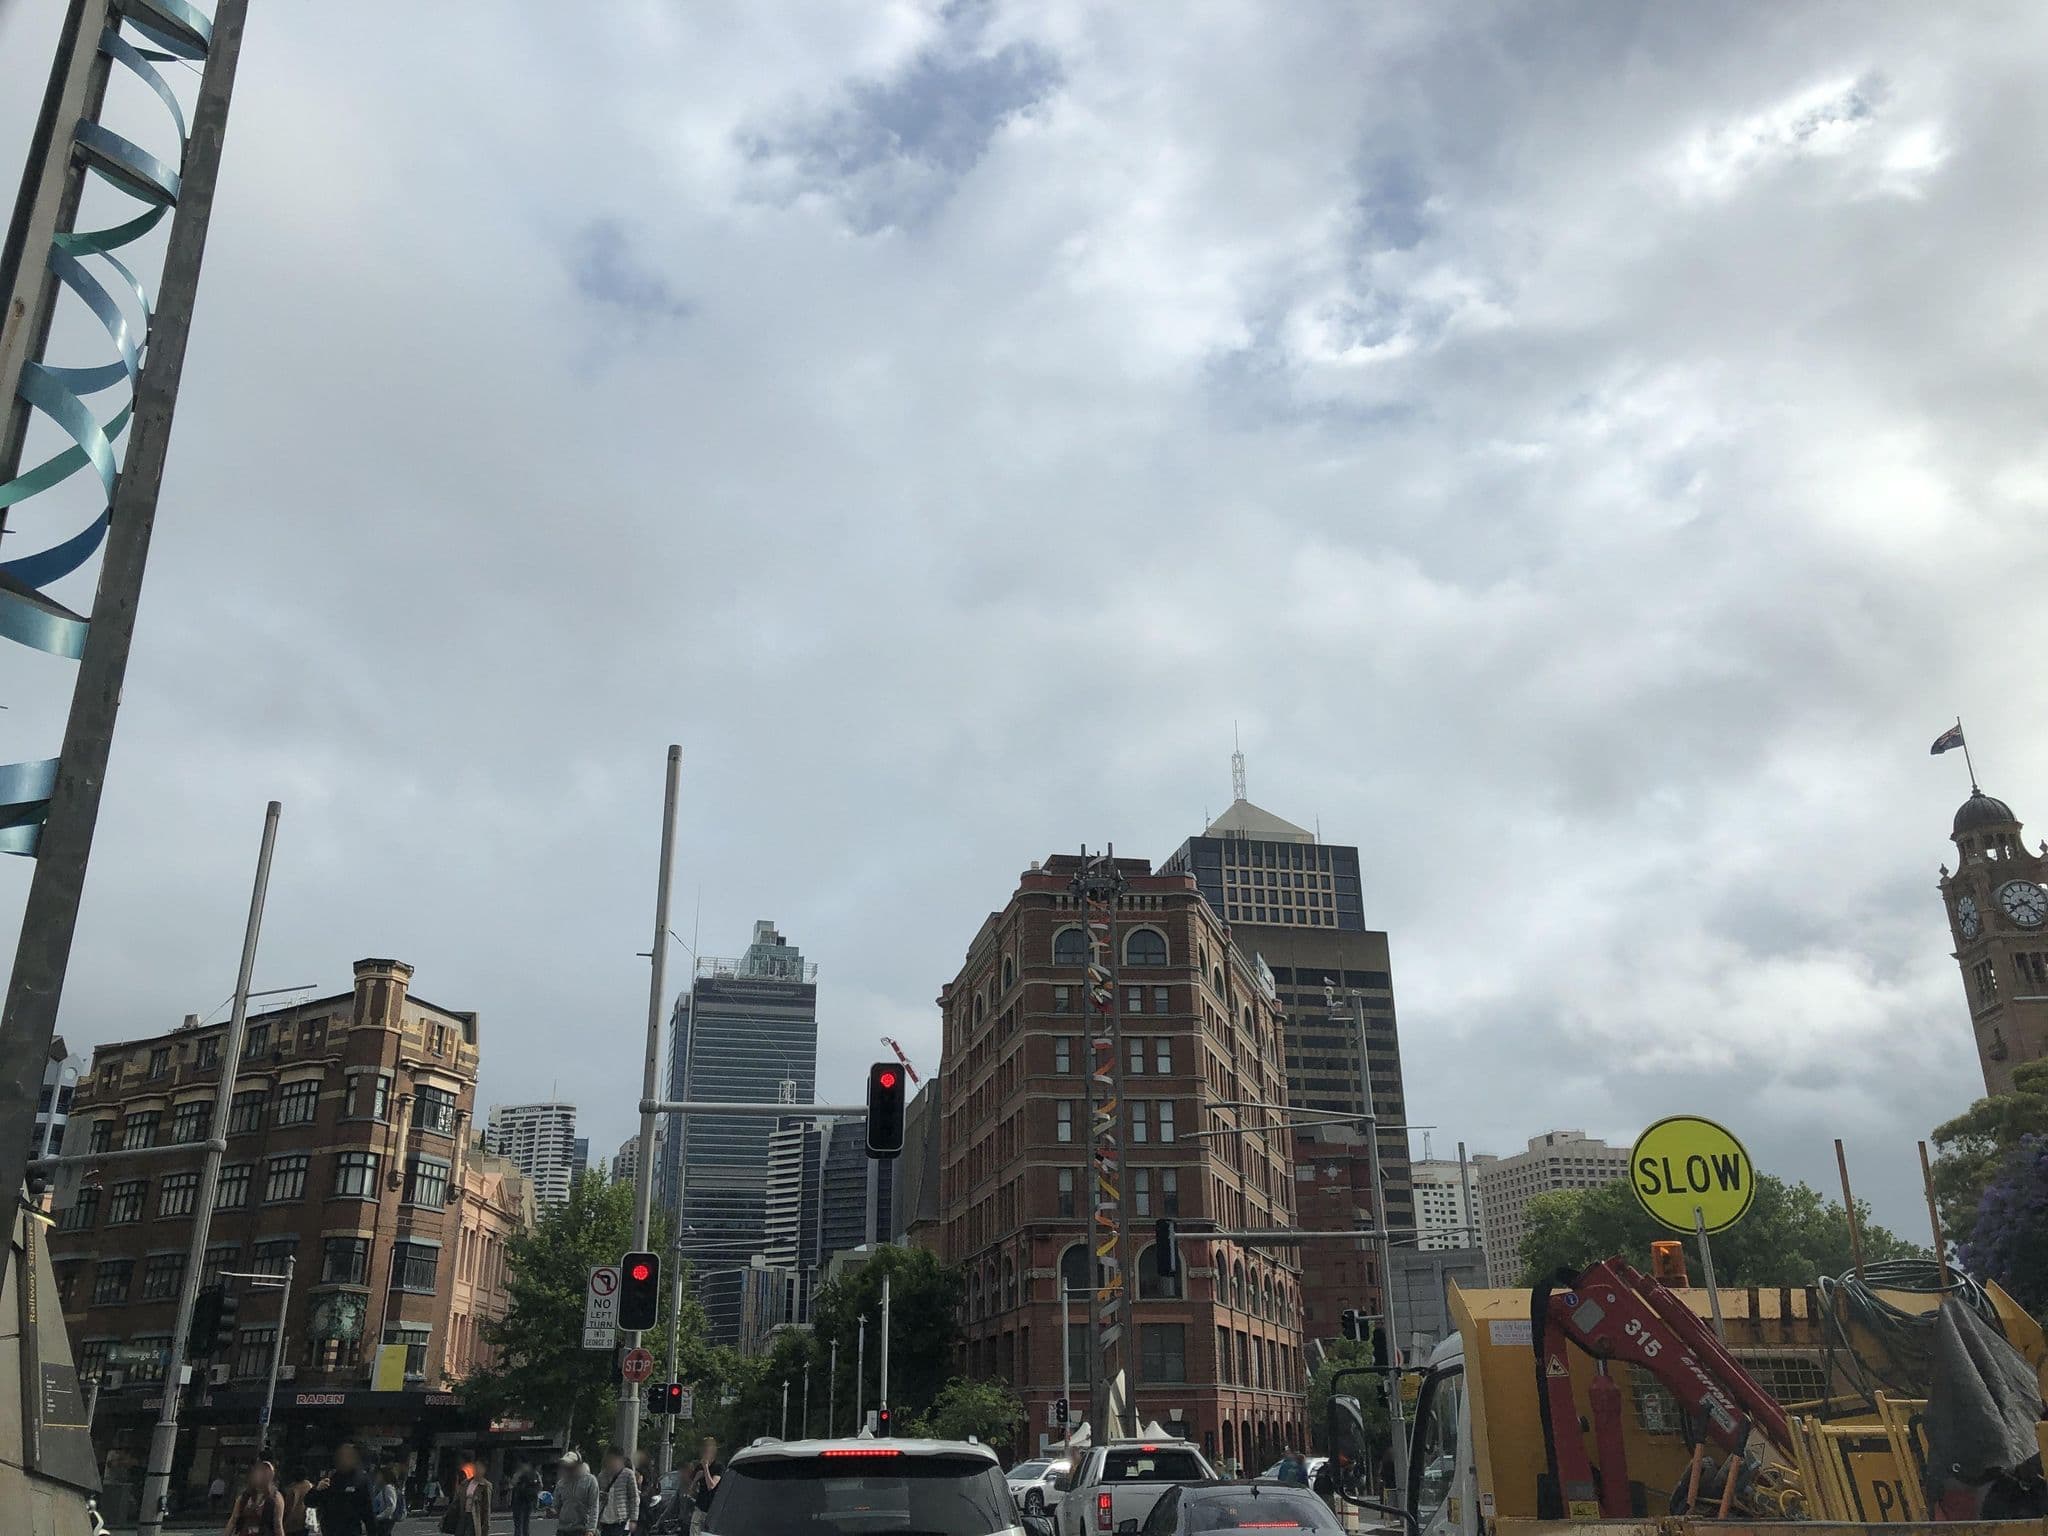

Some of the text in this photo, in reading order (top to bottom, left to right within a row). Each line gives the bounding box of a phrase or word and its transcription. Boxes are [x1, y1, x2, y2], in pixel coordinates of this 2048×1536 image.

[1638, 1153, 1740, 1195] SLOW
[27, 1221, 37, 1324] Railway Square
[593, 1298, 611, 1309] NO
[590, 1311, 612, 1319] LEFT
[589, 1320, 612, 1328] TURN
[1624, 1318, 1663, 1358] 315
[625, 1359, 651, 1372] STOP
[296, 1394, 345, 1405] RABEN
